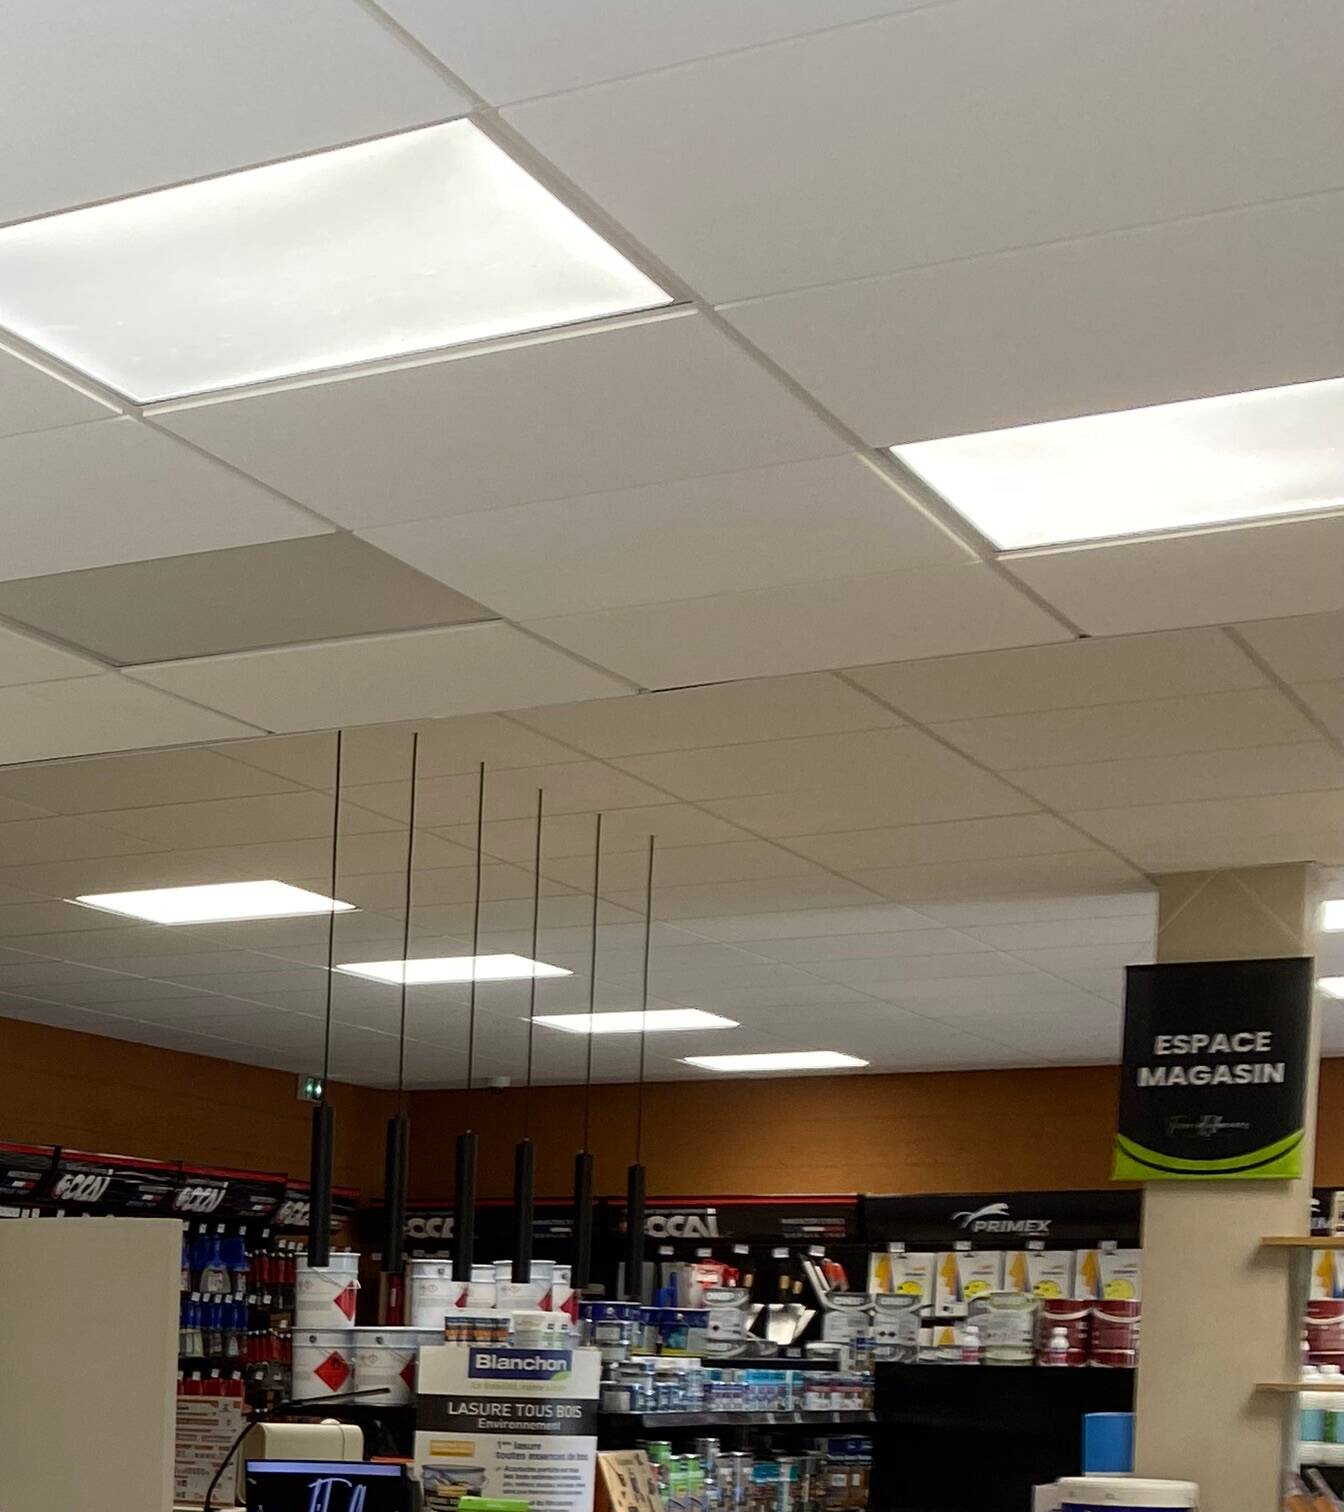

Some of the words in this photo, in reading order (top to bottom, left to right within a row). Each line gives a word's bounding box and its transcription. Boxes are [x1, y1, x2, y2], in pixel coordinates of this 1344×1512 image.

[1153, 1031, 1273, 1055] ESPACE
[1136, 1062, 1287, 1087] MAGASIN
[974, 1219, 1053, 1233] PRIMEX
[475, 1353, 567, 1371] Blanchon
[448, 1402, 512, 1417] LASURE
[515, 1404, 553, 1418] TOUS
[556, 1405, 583, 1418] BOIS
[478, 1418, 561, 1431] Environnement
